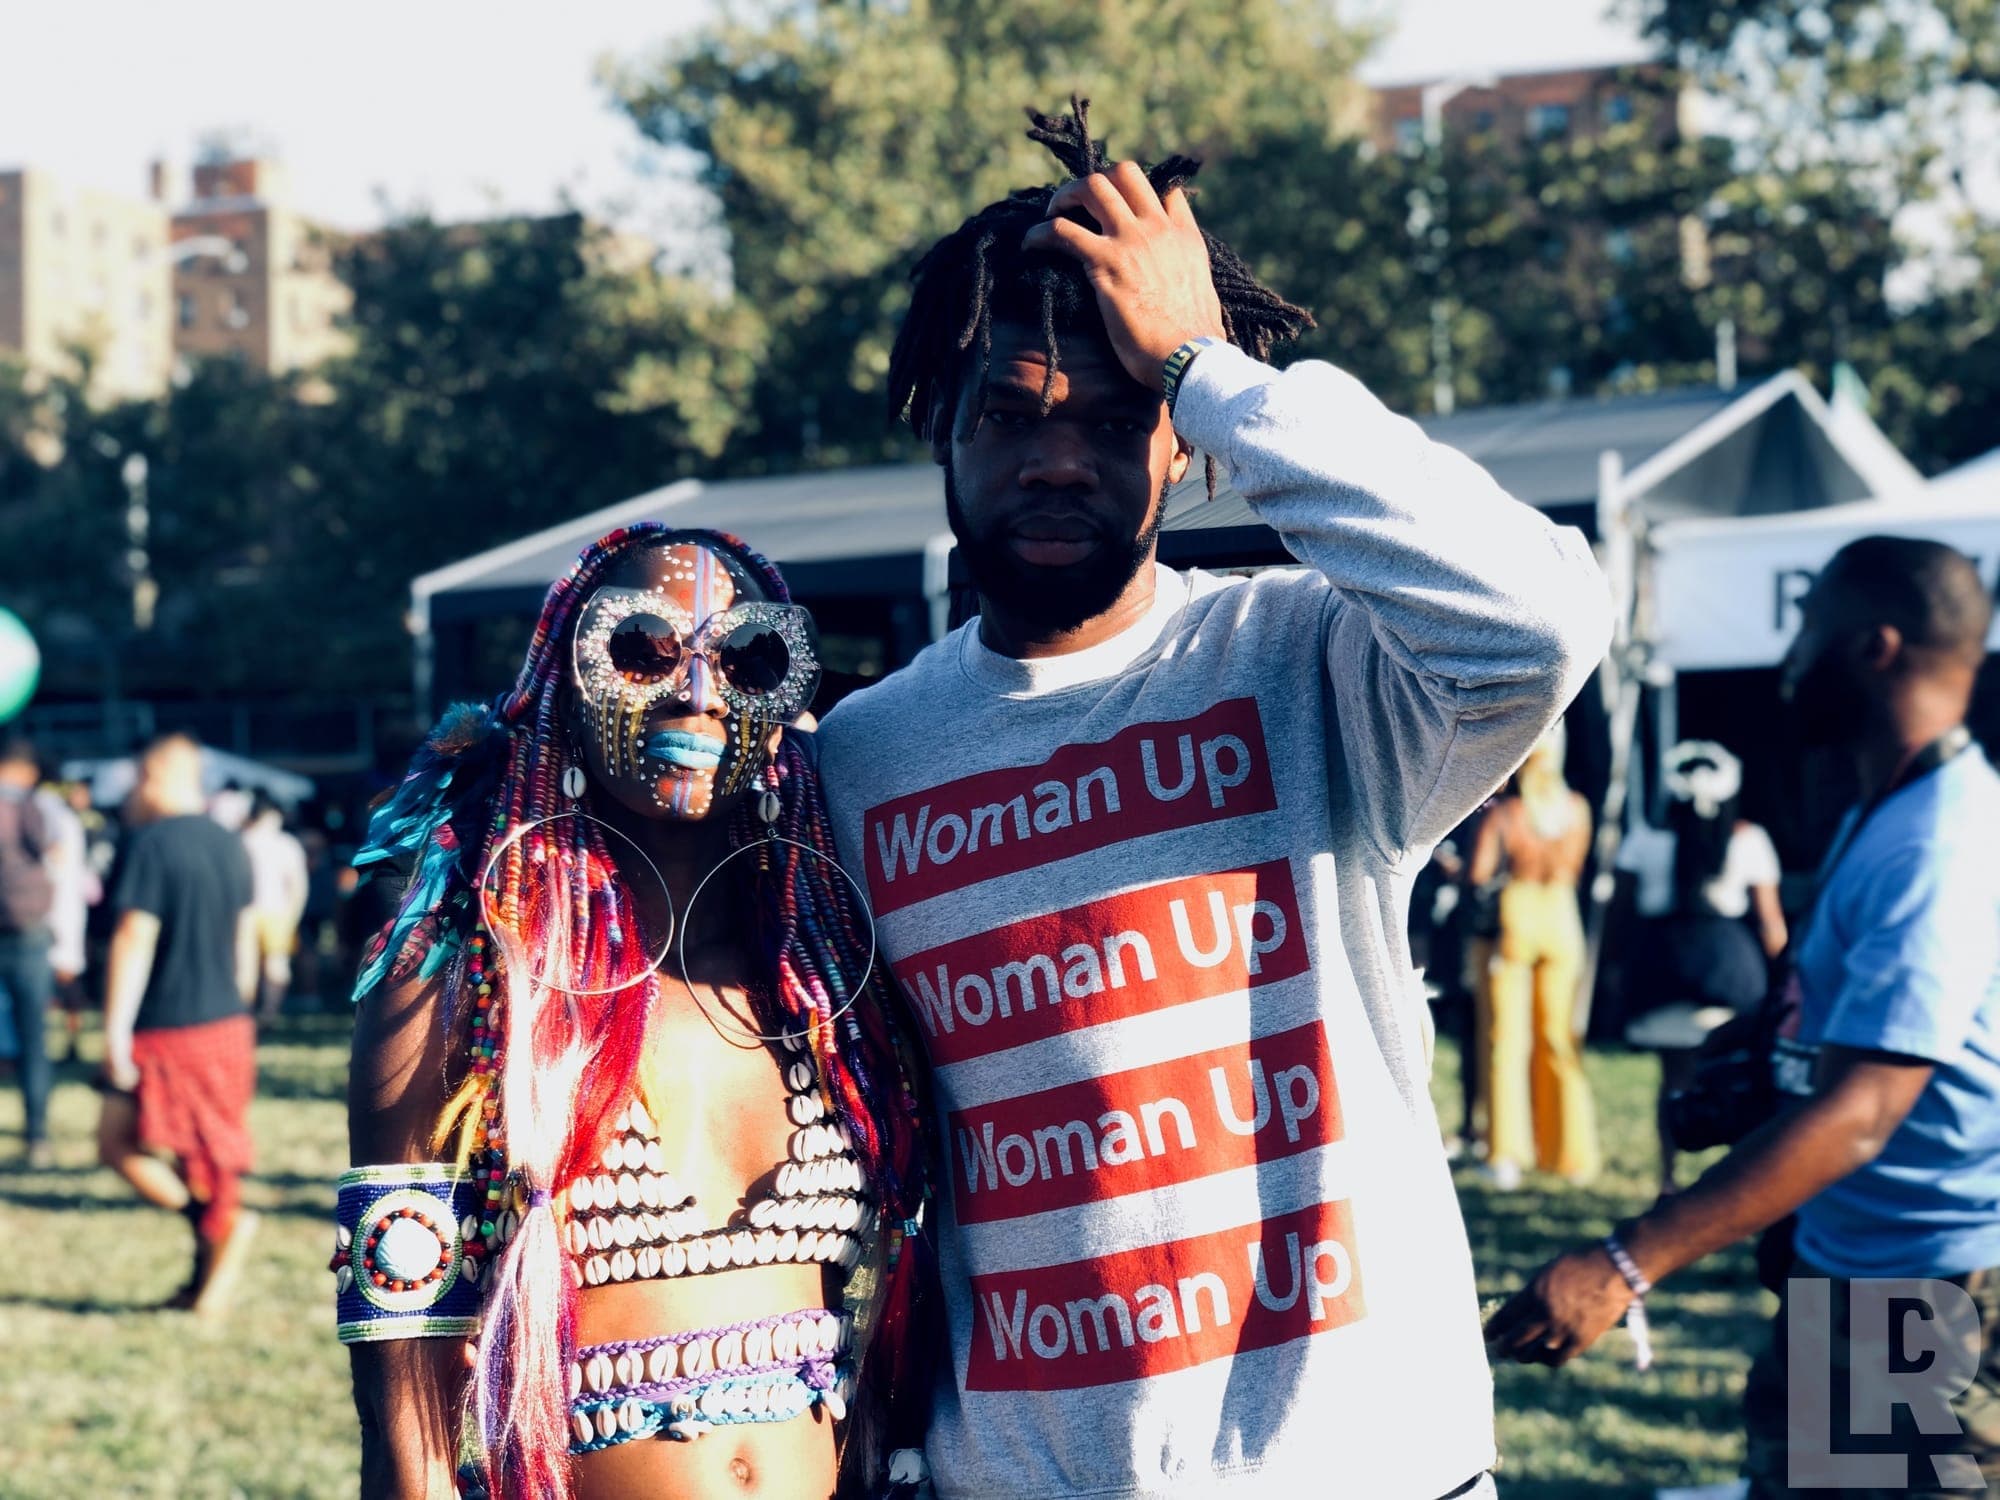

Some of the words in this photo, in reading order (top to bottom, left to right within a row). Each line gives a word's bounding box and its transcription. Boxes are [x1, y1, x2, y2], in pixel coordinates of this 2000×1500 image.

[874, 765, 1122, 883] Woman
[1140, 733, 1251, 809] Up
[902, 929, 1157, 1038] Woman
[1169, 891, 1287, 974] Up
[957, 1096, 1197, 1194] Woman
[1208, 1059, 1321, 1142] Up
[979, 1270, 1231, 1361] Woman
[1247, 1232, 1352, 1321] Up
